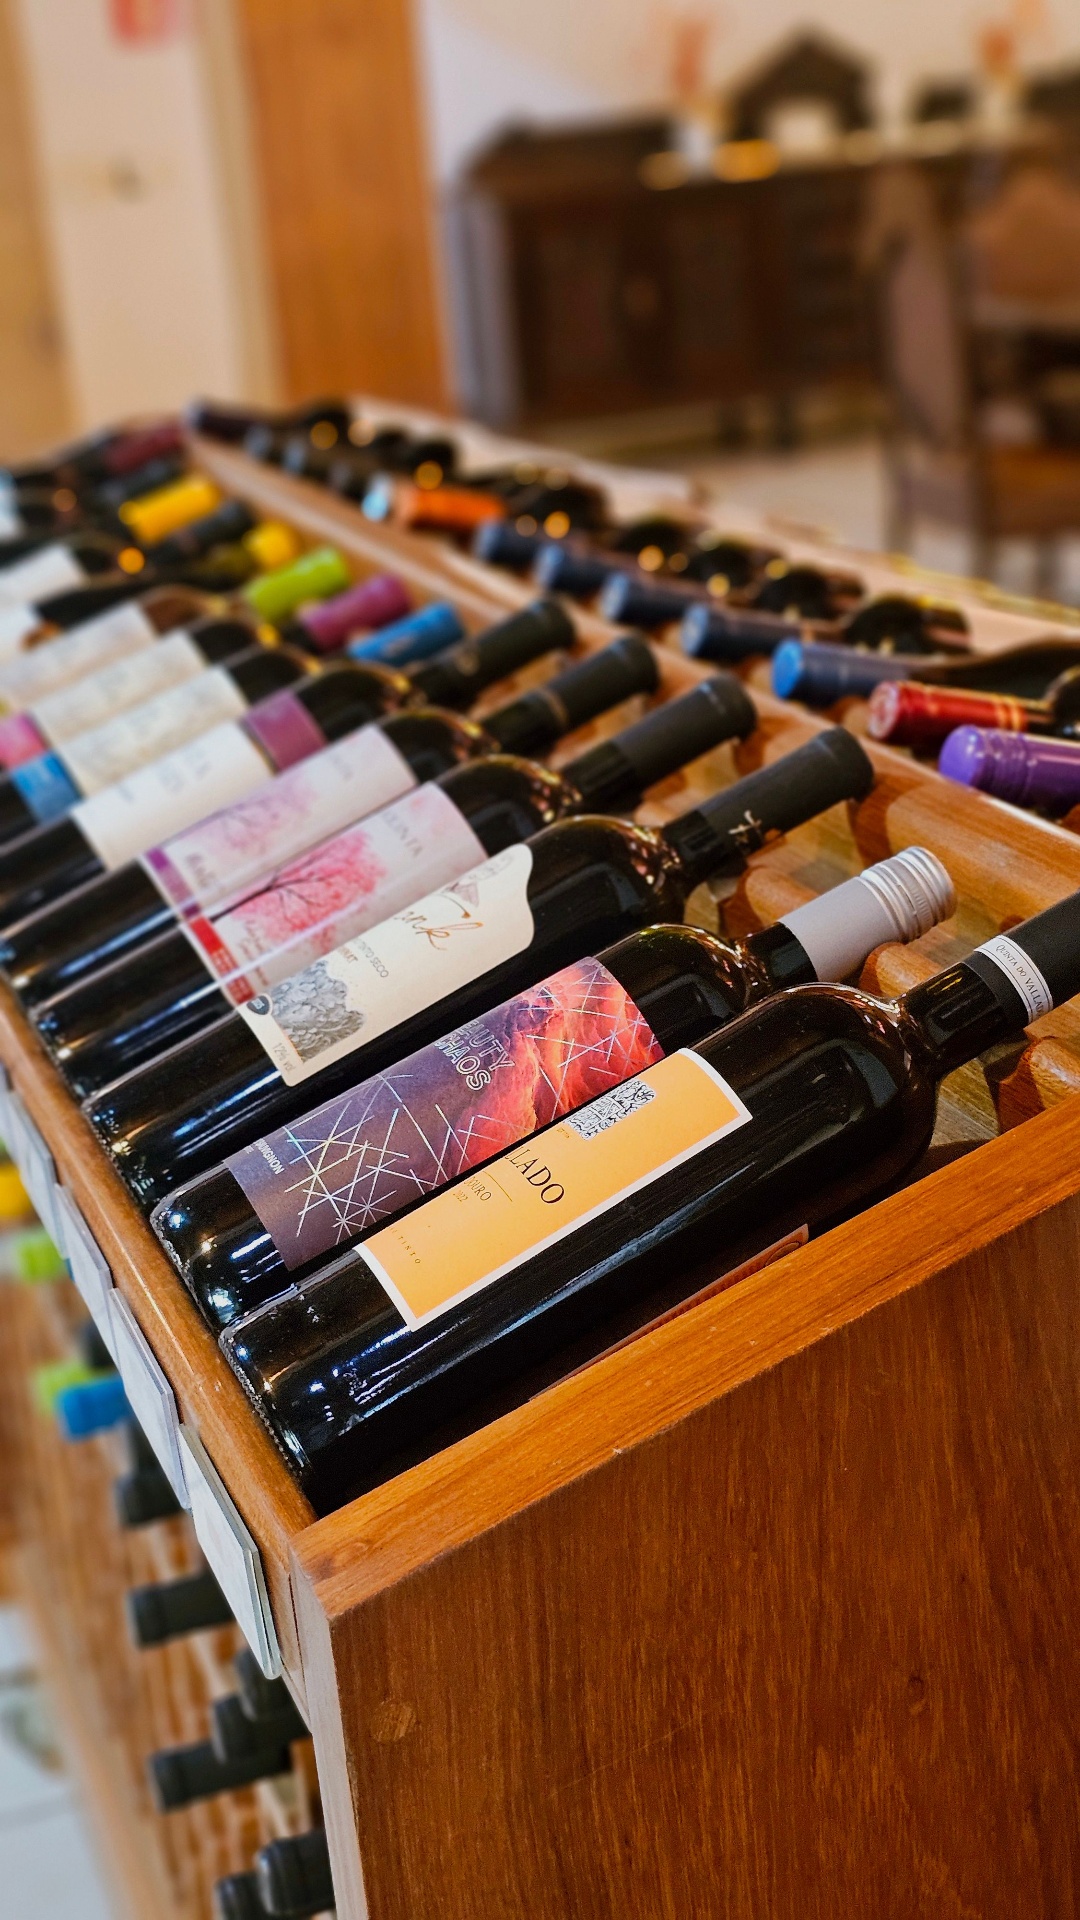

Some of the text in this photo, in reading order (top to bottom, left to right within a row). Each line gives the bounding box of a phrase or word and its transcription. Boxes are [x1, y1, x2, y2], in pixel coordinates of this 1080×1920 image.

[370, 957, 389, 978] SECO
[455, 1019, 516, 1072] EAUTY
[504, 1145, 565, 1205] LLADO
